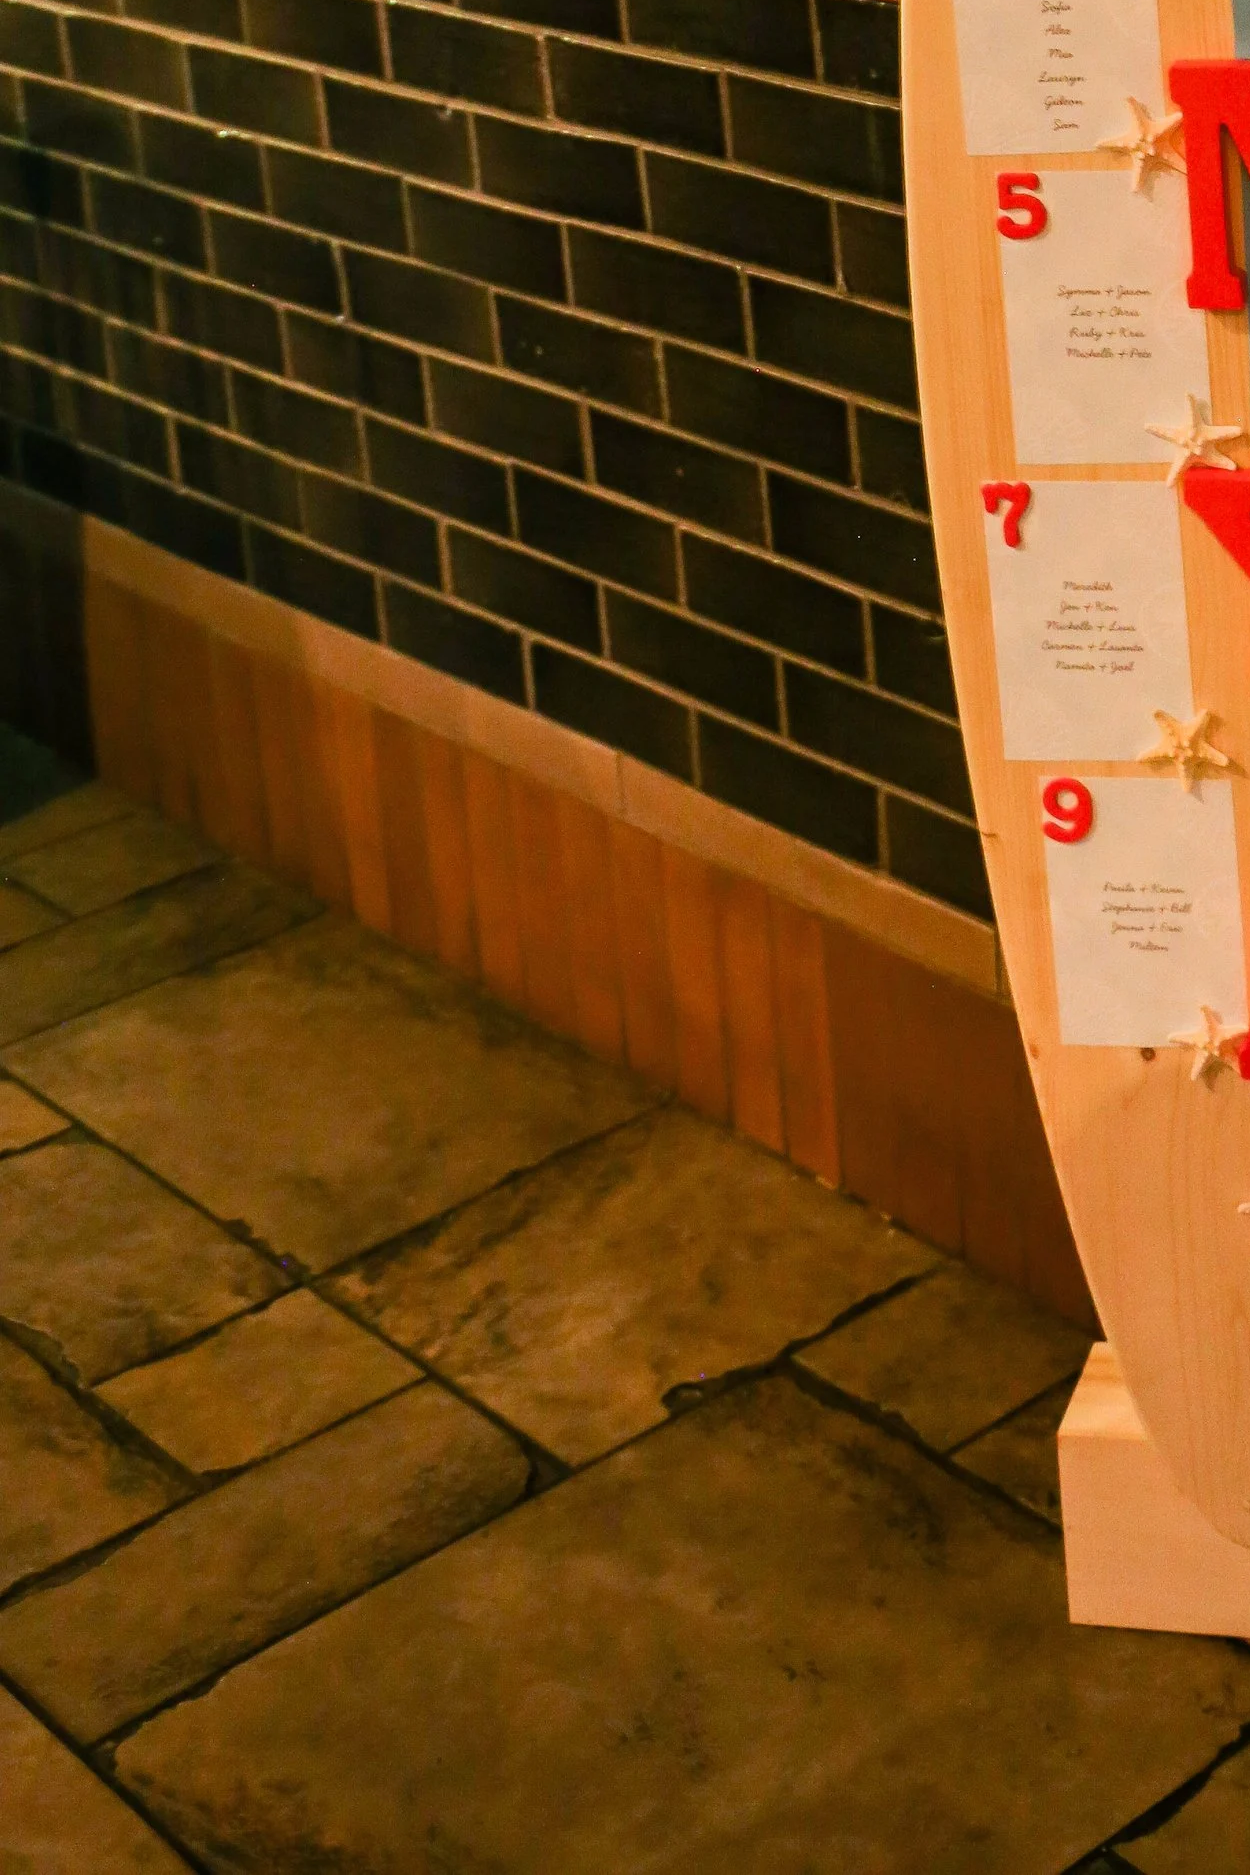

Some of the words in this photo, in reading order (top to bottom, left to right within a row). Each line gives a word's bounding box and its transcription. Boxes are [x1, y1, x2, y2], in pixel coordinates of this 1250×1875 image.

[997, 172, 1048, 241] 5
[981, 482, 1031, 549] 7
[1042, 777, 1094, 844] 9
